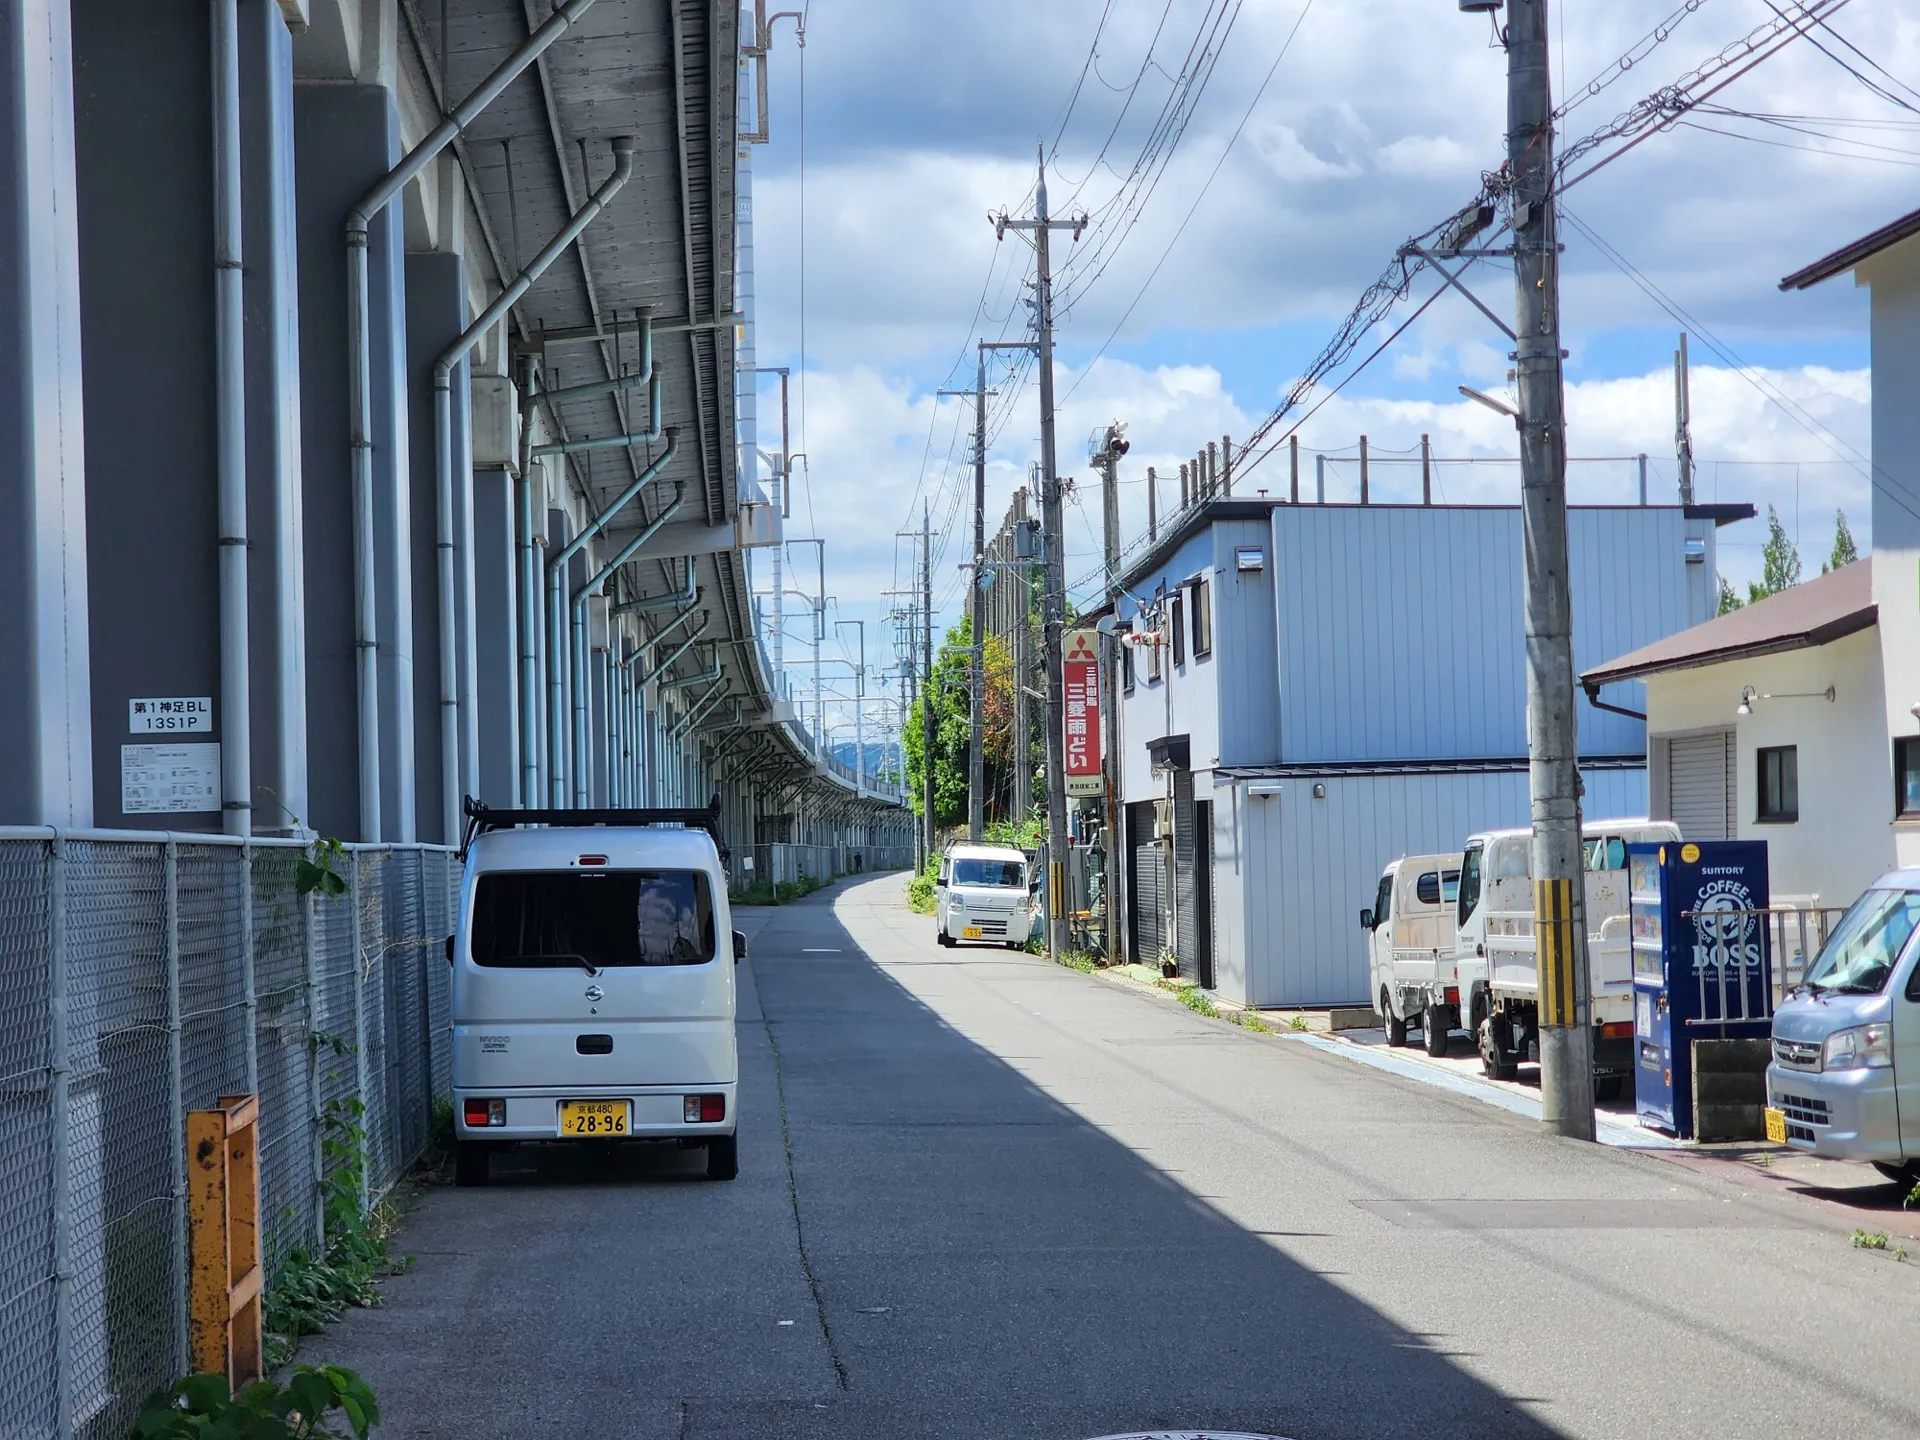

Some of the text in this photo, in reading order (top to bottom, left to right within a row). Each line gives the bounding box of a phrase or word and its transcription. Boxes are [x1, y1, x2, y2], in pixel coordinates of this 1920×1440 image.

[146, 717, 198, 729] 13S1P
[1067, 683, 1087, 769] 三菱雨どい
[1701, 866, 1745, 875] SUNTORY
[1697, 879, 1750, 899] COFFEE
[1691, 943, 1760, 968] BOSS
[576, 1115, 624, 1133] 28-96
